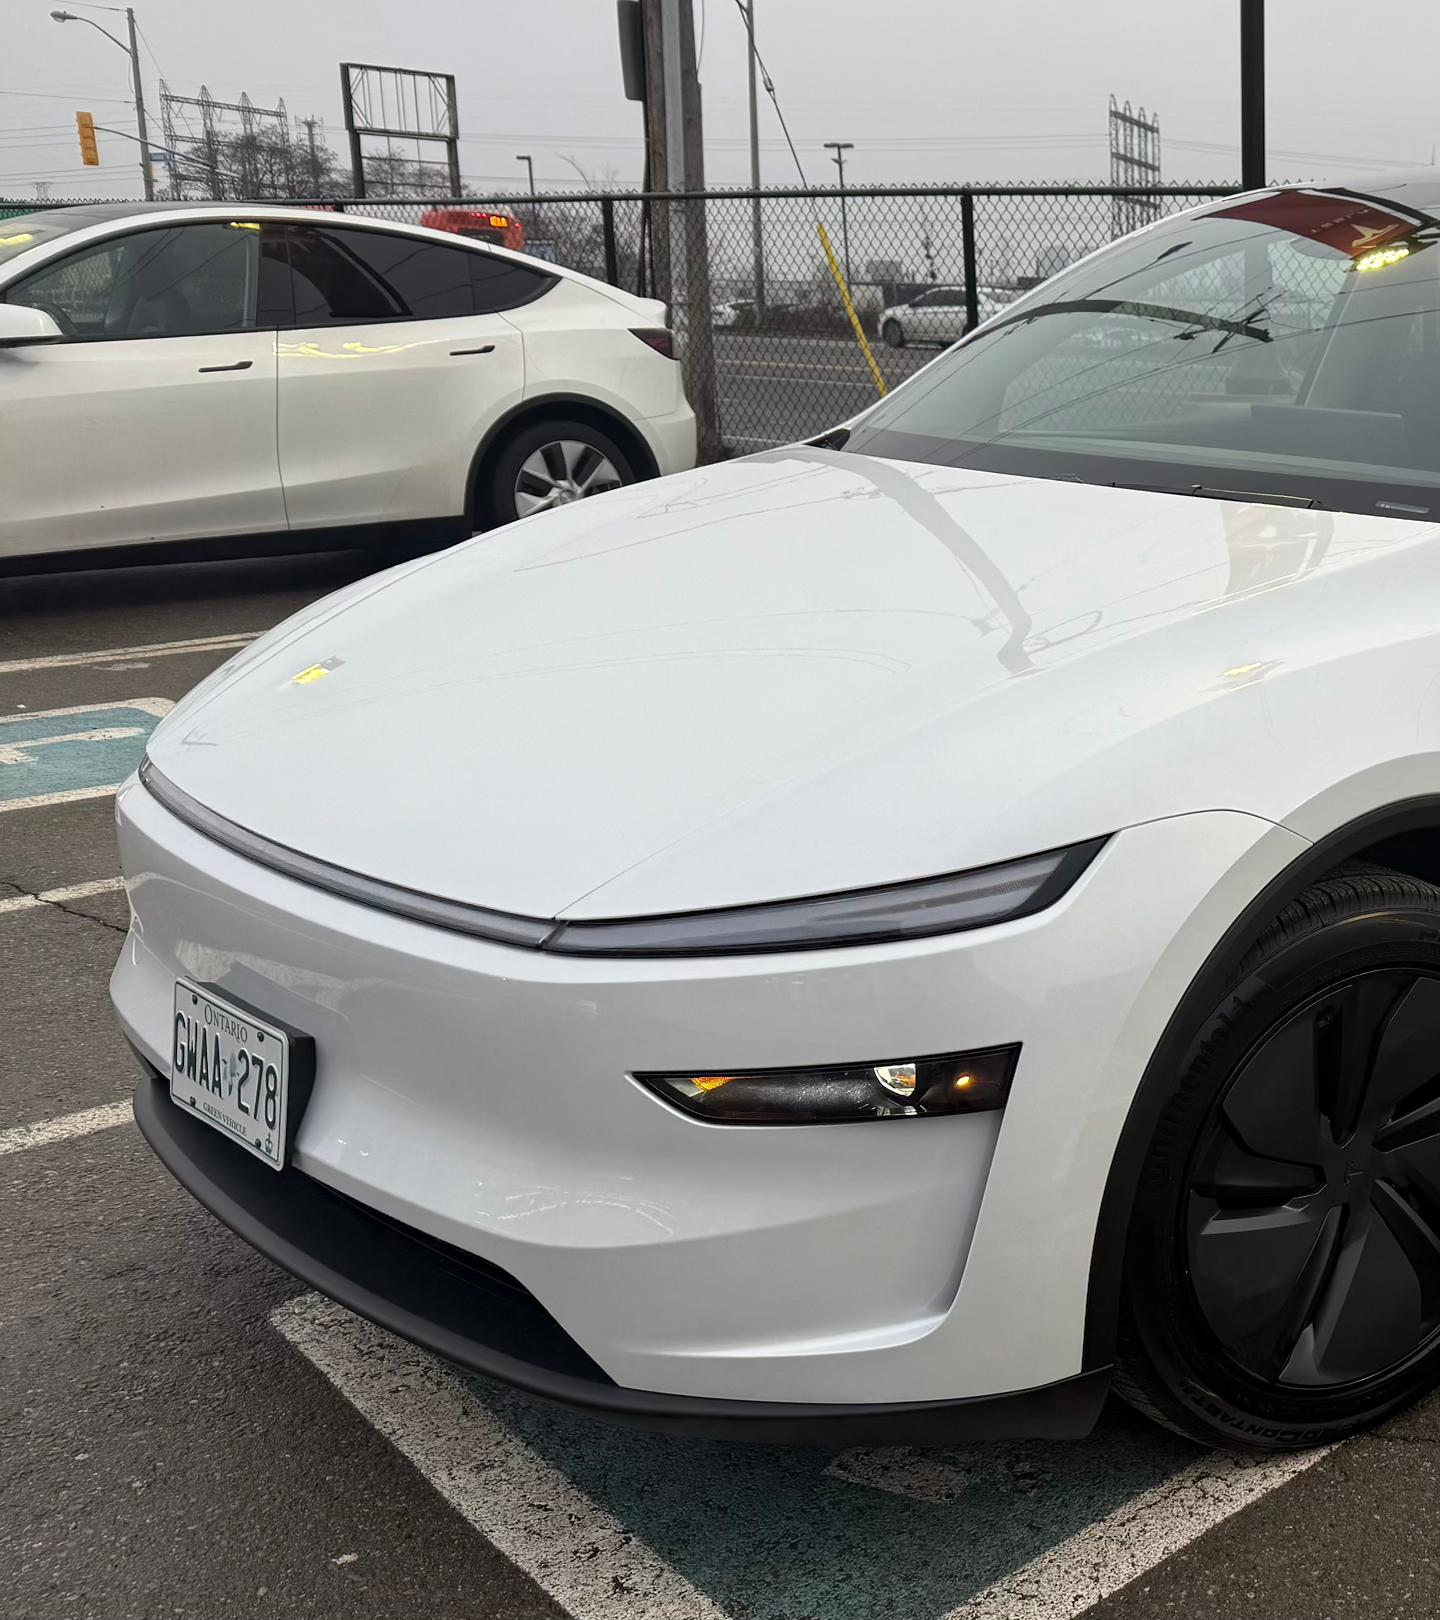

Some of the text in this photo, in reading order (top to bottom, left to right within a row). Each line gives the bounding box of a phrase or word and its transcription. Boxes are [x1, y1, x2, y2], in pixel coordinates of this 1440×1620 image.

[204, 1004, 248, 1044] ONTARIO
[174, 1012, 277, 1130] GWAA 278
[203, 1102, 247, 1136] GREEN VEHICLE
[1192, 1395, 1359, 1442] OCONTACT
